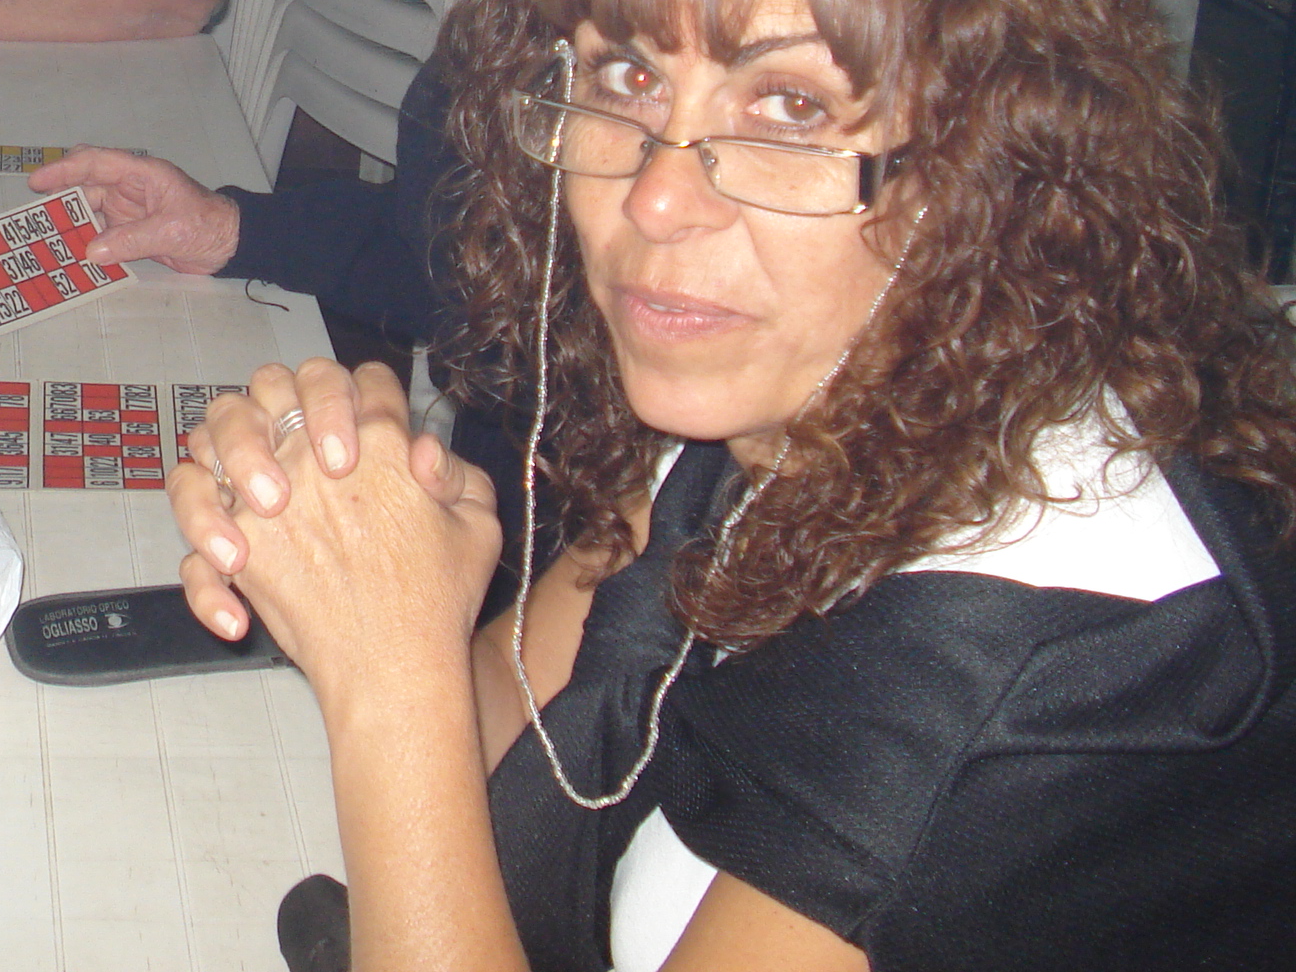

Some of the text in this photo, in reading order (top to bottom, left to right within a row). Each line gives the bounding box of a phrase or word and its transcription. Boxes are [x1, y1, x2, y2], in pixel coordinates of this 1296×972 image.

[3, 222, 21, 244] 41
[17, 217, 39, 239] 54
[33, 210, 54, 233] 63
[65, 197, 87, 223] 87
[2, 257, 23, 280] 37
[19, 250, 40, 274] 46
[49, 240, 72, 263] 62
[5, 291, 29, 314] 22
[52, 273, 77, 296] 52
[179, 386, 206, 397] 84
[181, 399, 207, 410] 72
[51, 383, 79, 455] 31 47 66 70 83
[89, 410, 115, 421] 63
[182, 412, 205, 421] 61
[125, 386, 159, 477] 17 38 56 77 82
[89, 434, 116, 445] 40
[91, 457, 118, 467] 22
[90, 469, 118, 477] 10
[42, 617, 98, 640] OGLIASSO
